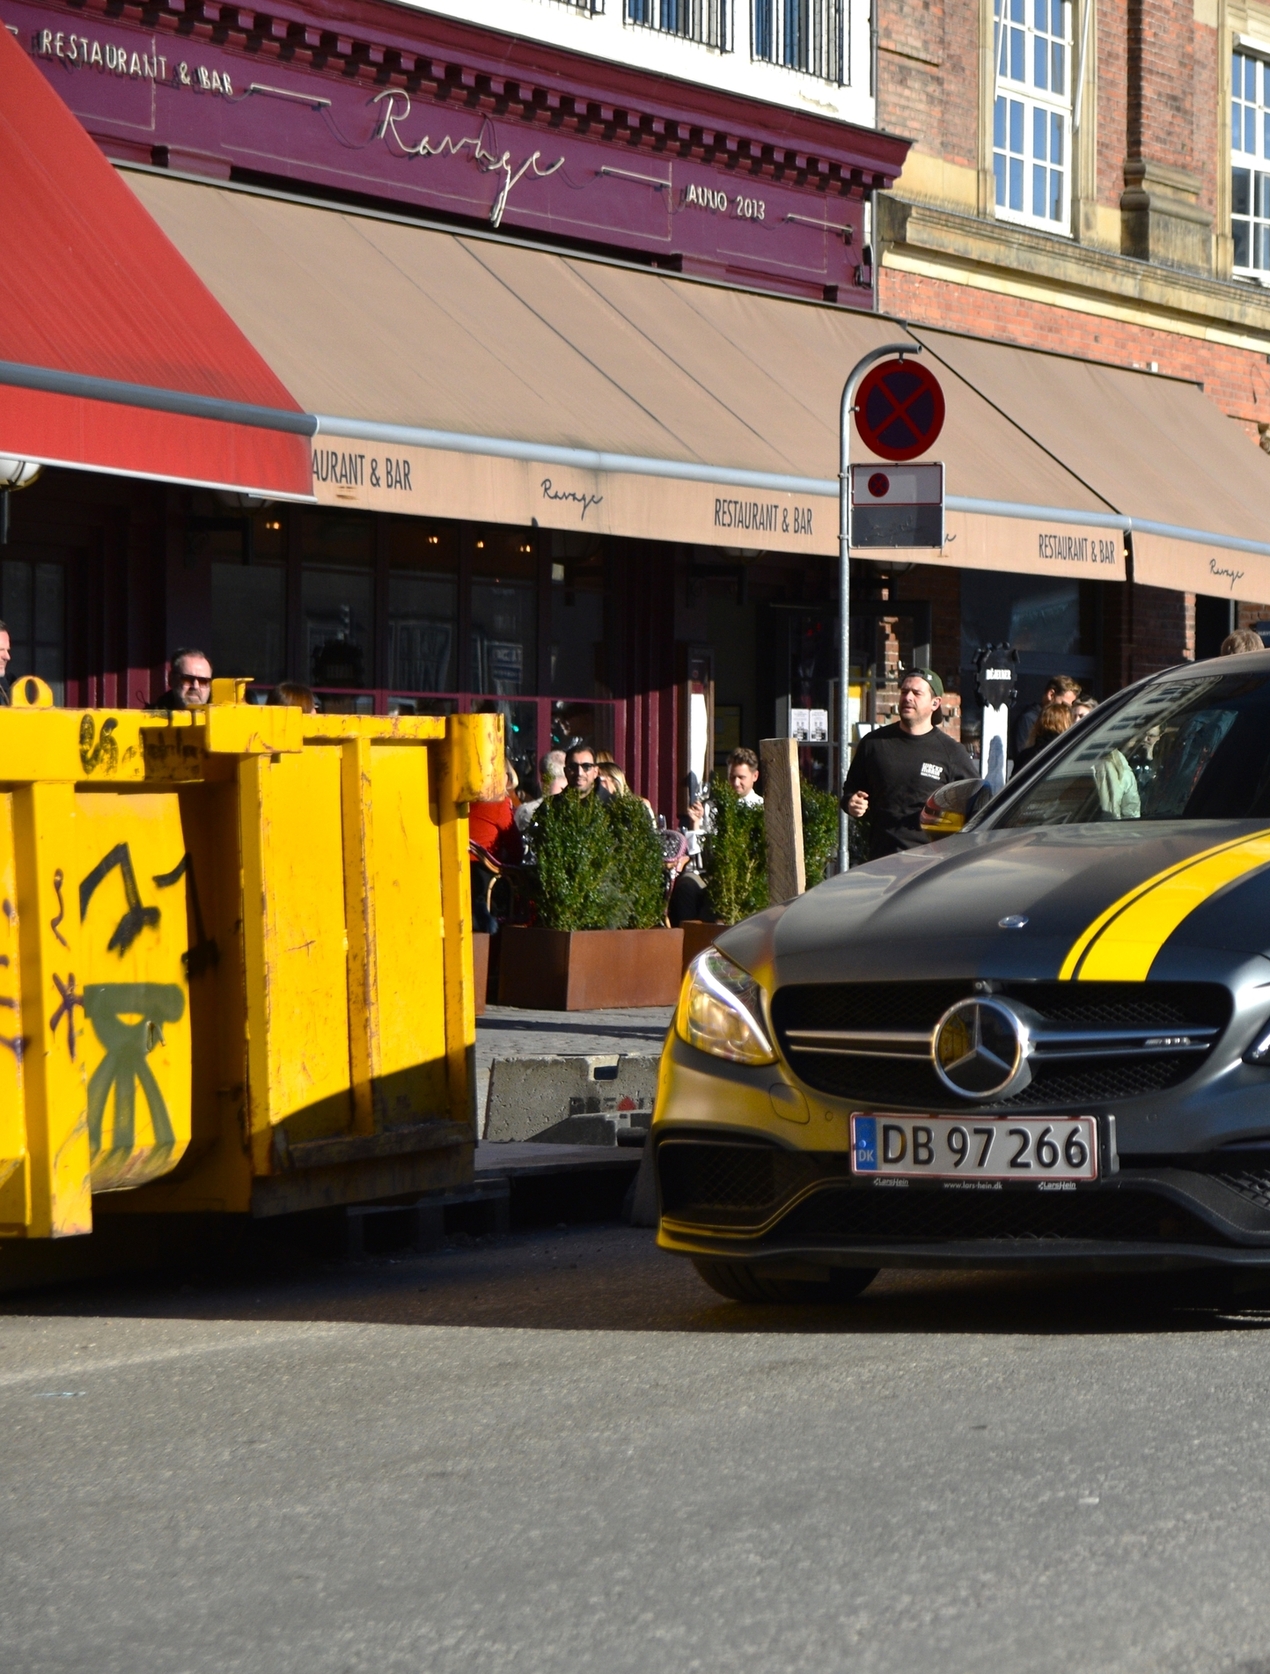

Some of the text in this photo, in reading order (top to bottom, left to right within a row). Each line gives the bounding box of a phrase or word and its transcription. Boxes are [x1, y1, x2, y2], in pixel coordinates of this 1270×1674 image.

[40, 28, 233, 95] RESTAURANT & BAR
[687, 183, 765, 220] ANNO 2013
[370, 458, 381, 488] &
[386, 457, 412, 491] BAR
[540, 478, 603, 521] Ravage
[714, 498, 813, 535] RESTAURANT & BAR
[1038, 533, 1115, 565] RESTAURANT & BAR
[1209, 558, 1245, 591] Ravage
[858, 1149, 874, 1162] DK
[882, 1123, 1090, 1169] DB 97 266
